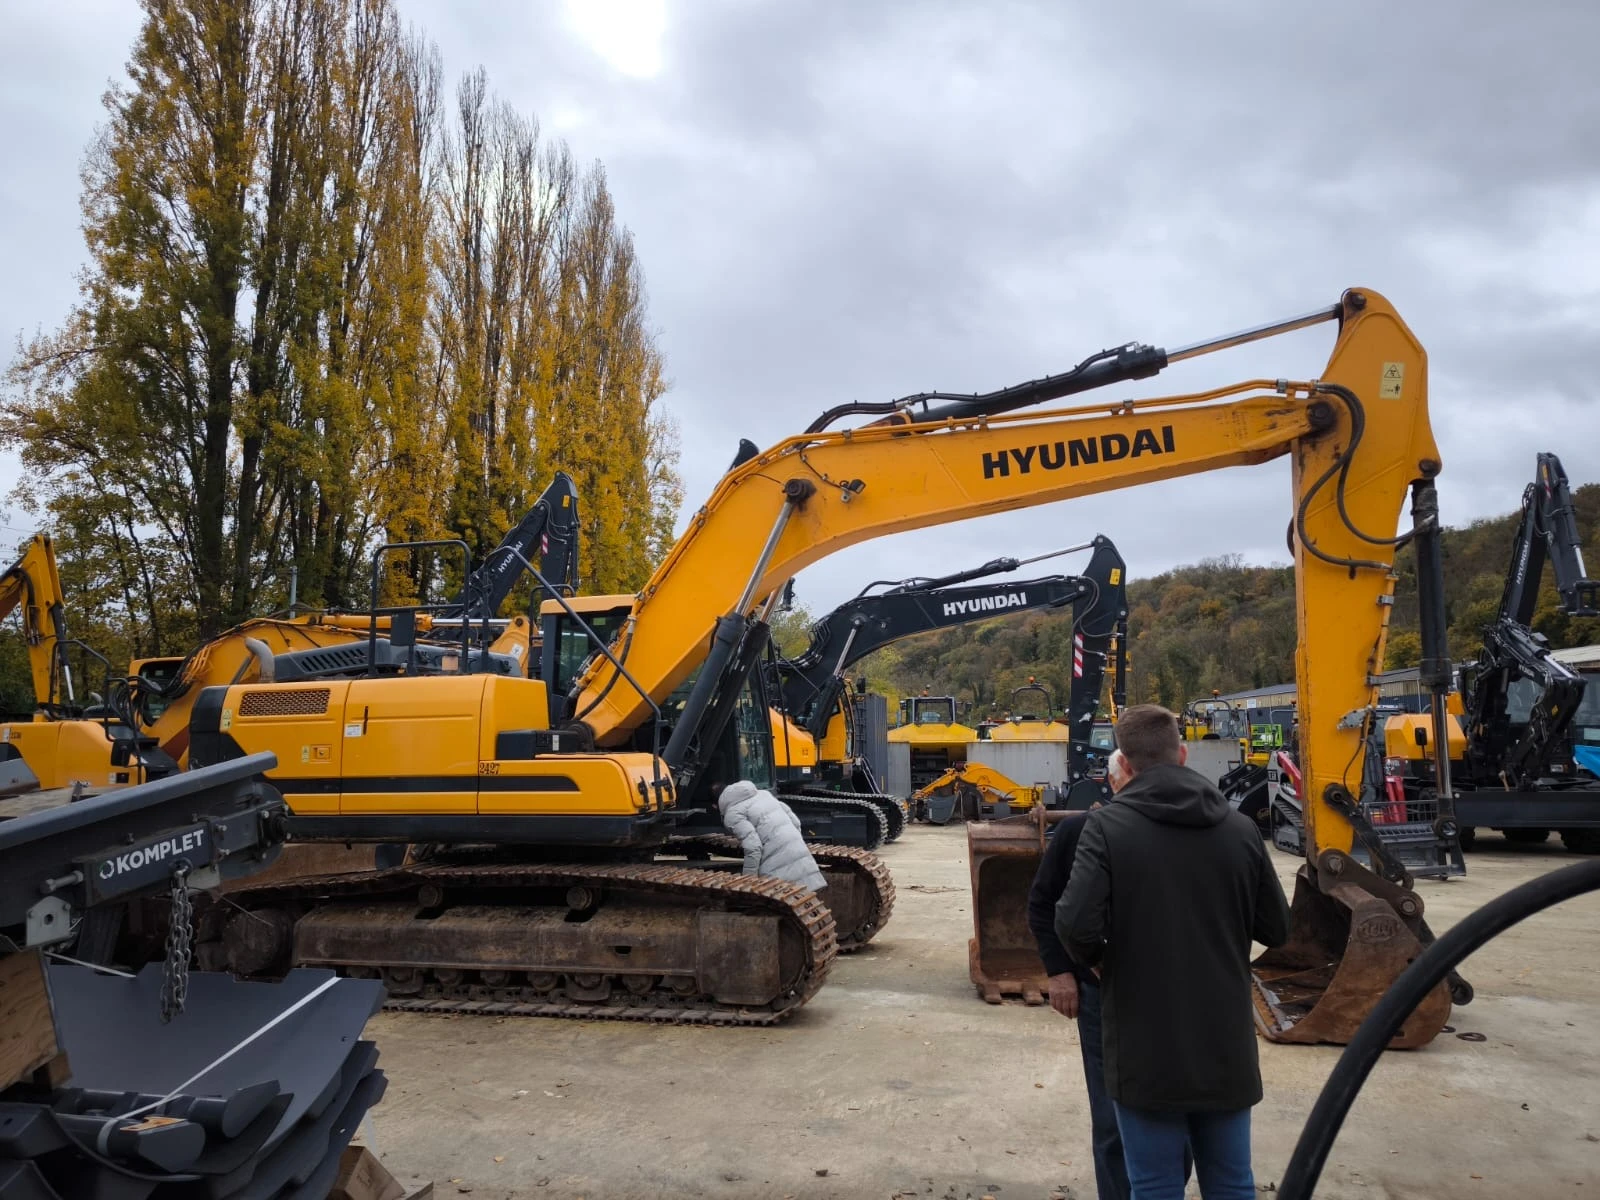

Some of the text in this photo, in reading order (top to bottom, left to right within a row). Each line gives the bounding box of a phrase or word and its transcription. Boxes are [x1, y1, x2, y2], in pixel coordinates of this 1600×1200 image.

[982, 425, 1176, 479] HYUNDAI
[943, 592, 1027, 616] HYUNDAI
[116, 829, 204, 874] KOMPLET
